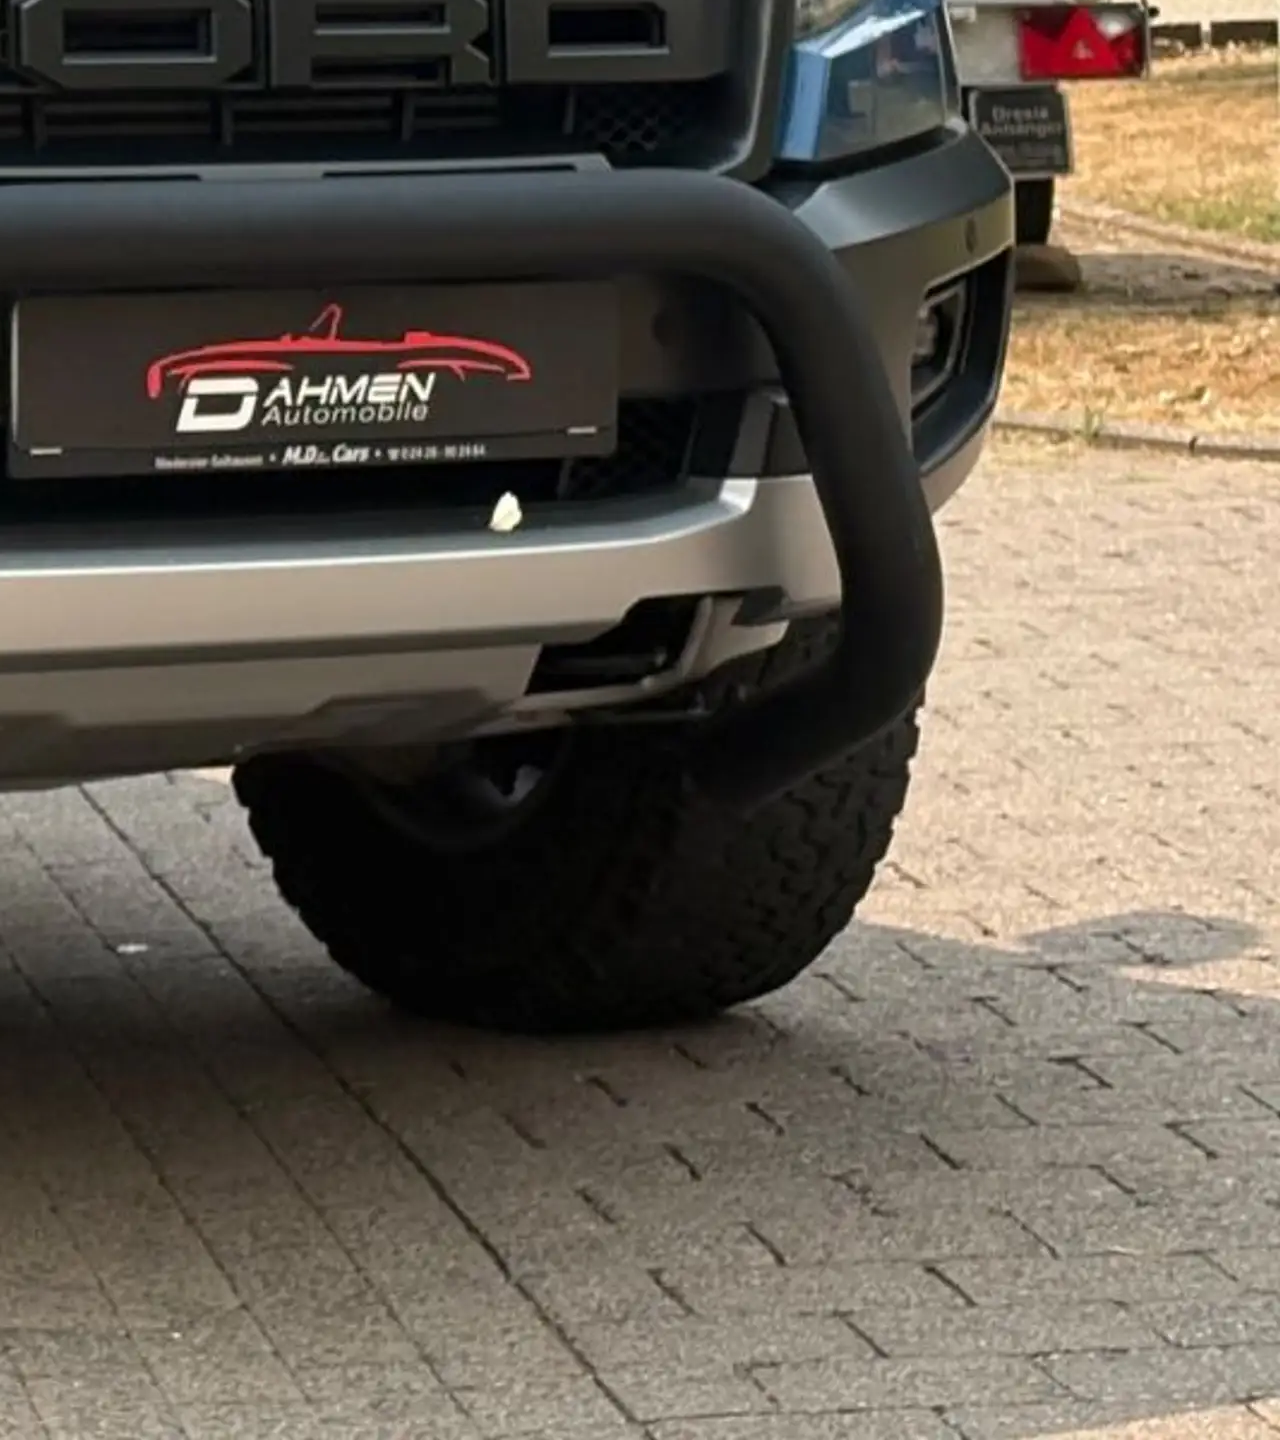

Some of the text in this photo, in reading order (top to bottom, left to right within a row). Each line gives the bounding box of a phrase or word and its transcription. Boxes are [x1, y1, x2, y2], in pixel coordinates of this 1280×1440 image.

[176, 372, 436, 432] DAHMEN
[260, 402, 429, 426] Automobile
[332, 442, 370, 462] Cars
